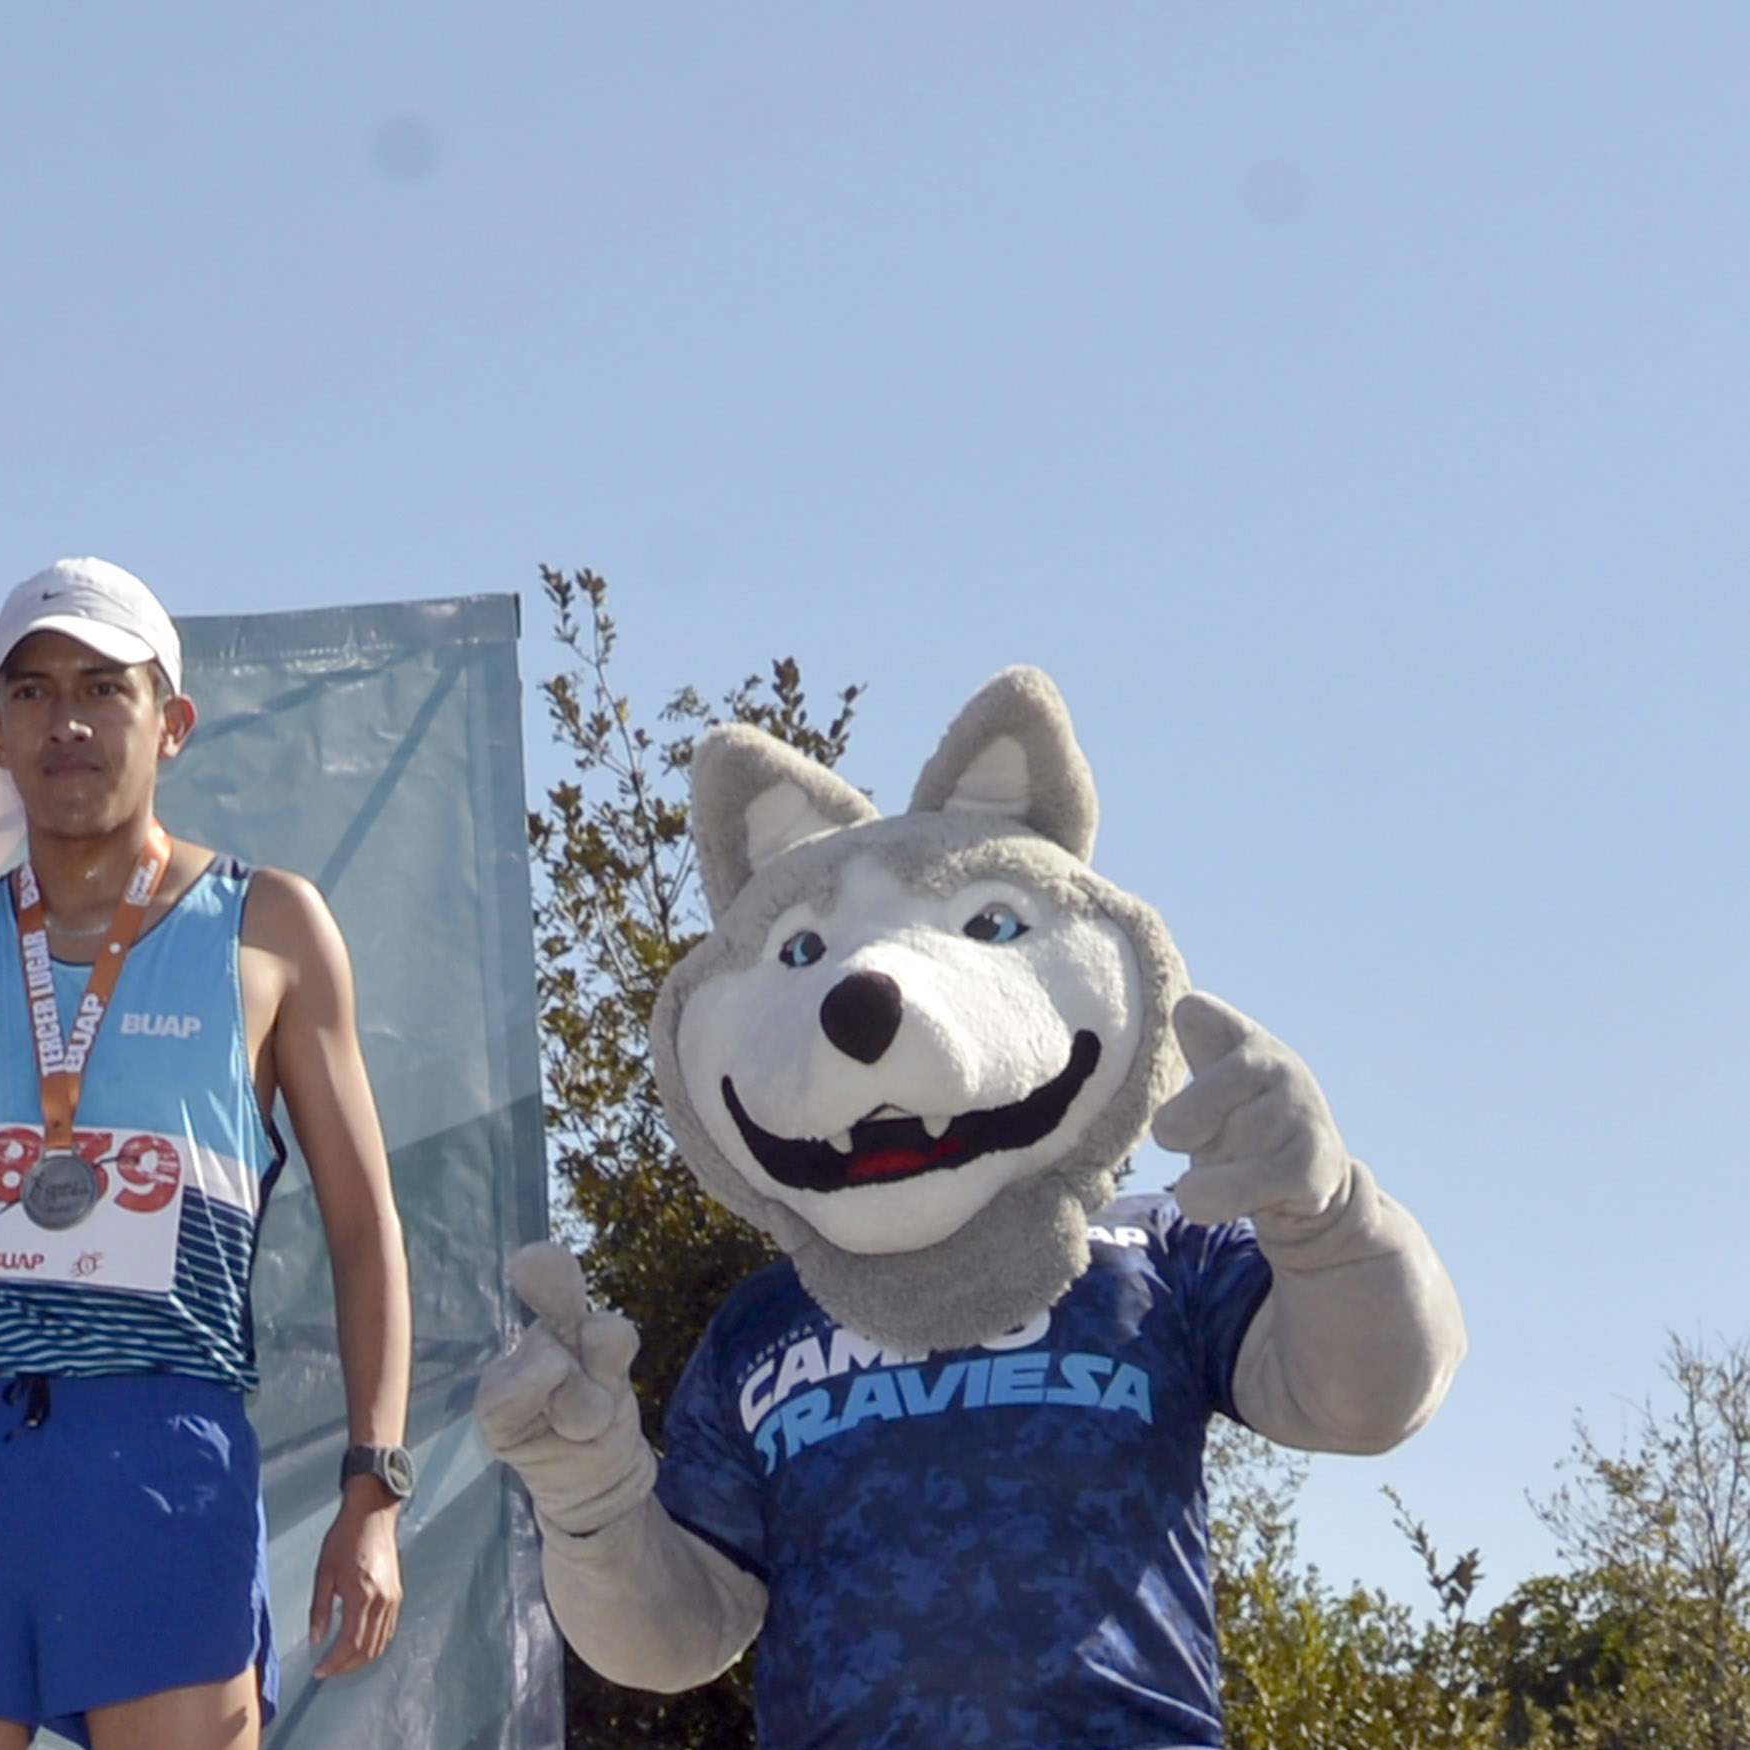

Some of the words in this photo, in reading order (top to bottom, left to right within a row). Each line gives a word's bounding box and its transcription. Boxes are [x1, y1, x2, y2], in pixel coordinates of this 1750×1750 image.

[22, 929, 56, 998] LUGAR
[32, 998, 65, 1077] TERCER
[63, 993, 104, 1073] BUAP
[120, 1012, 202, 1039] BUAP
[1085, 1225, 1149, 1247] AP
[753, 1351, 1154, 1477] TRAVIESA
